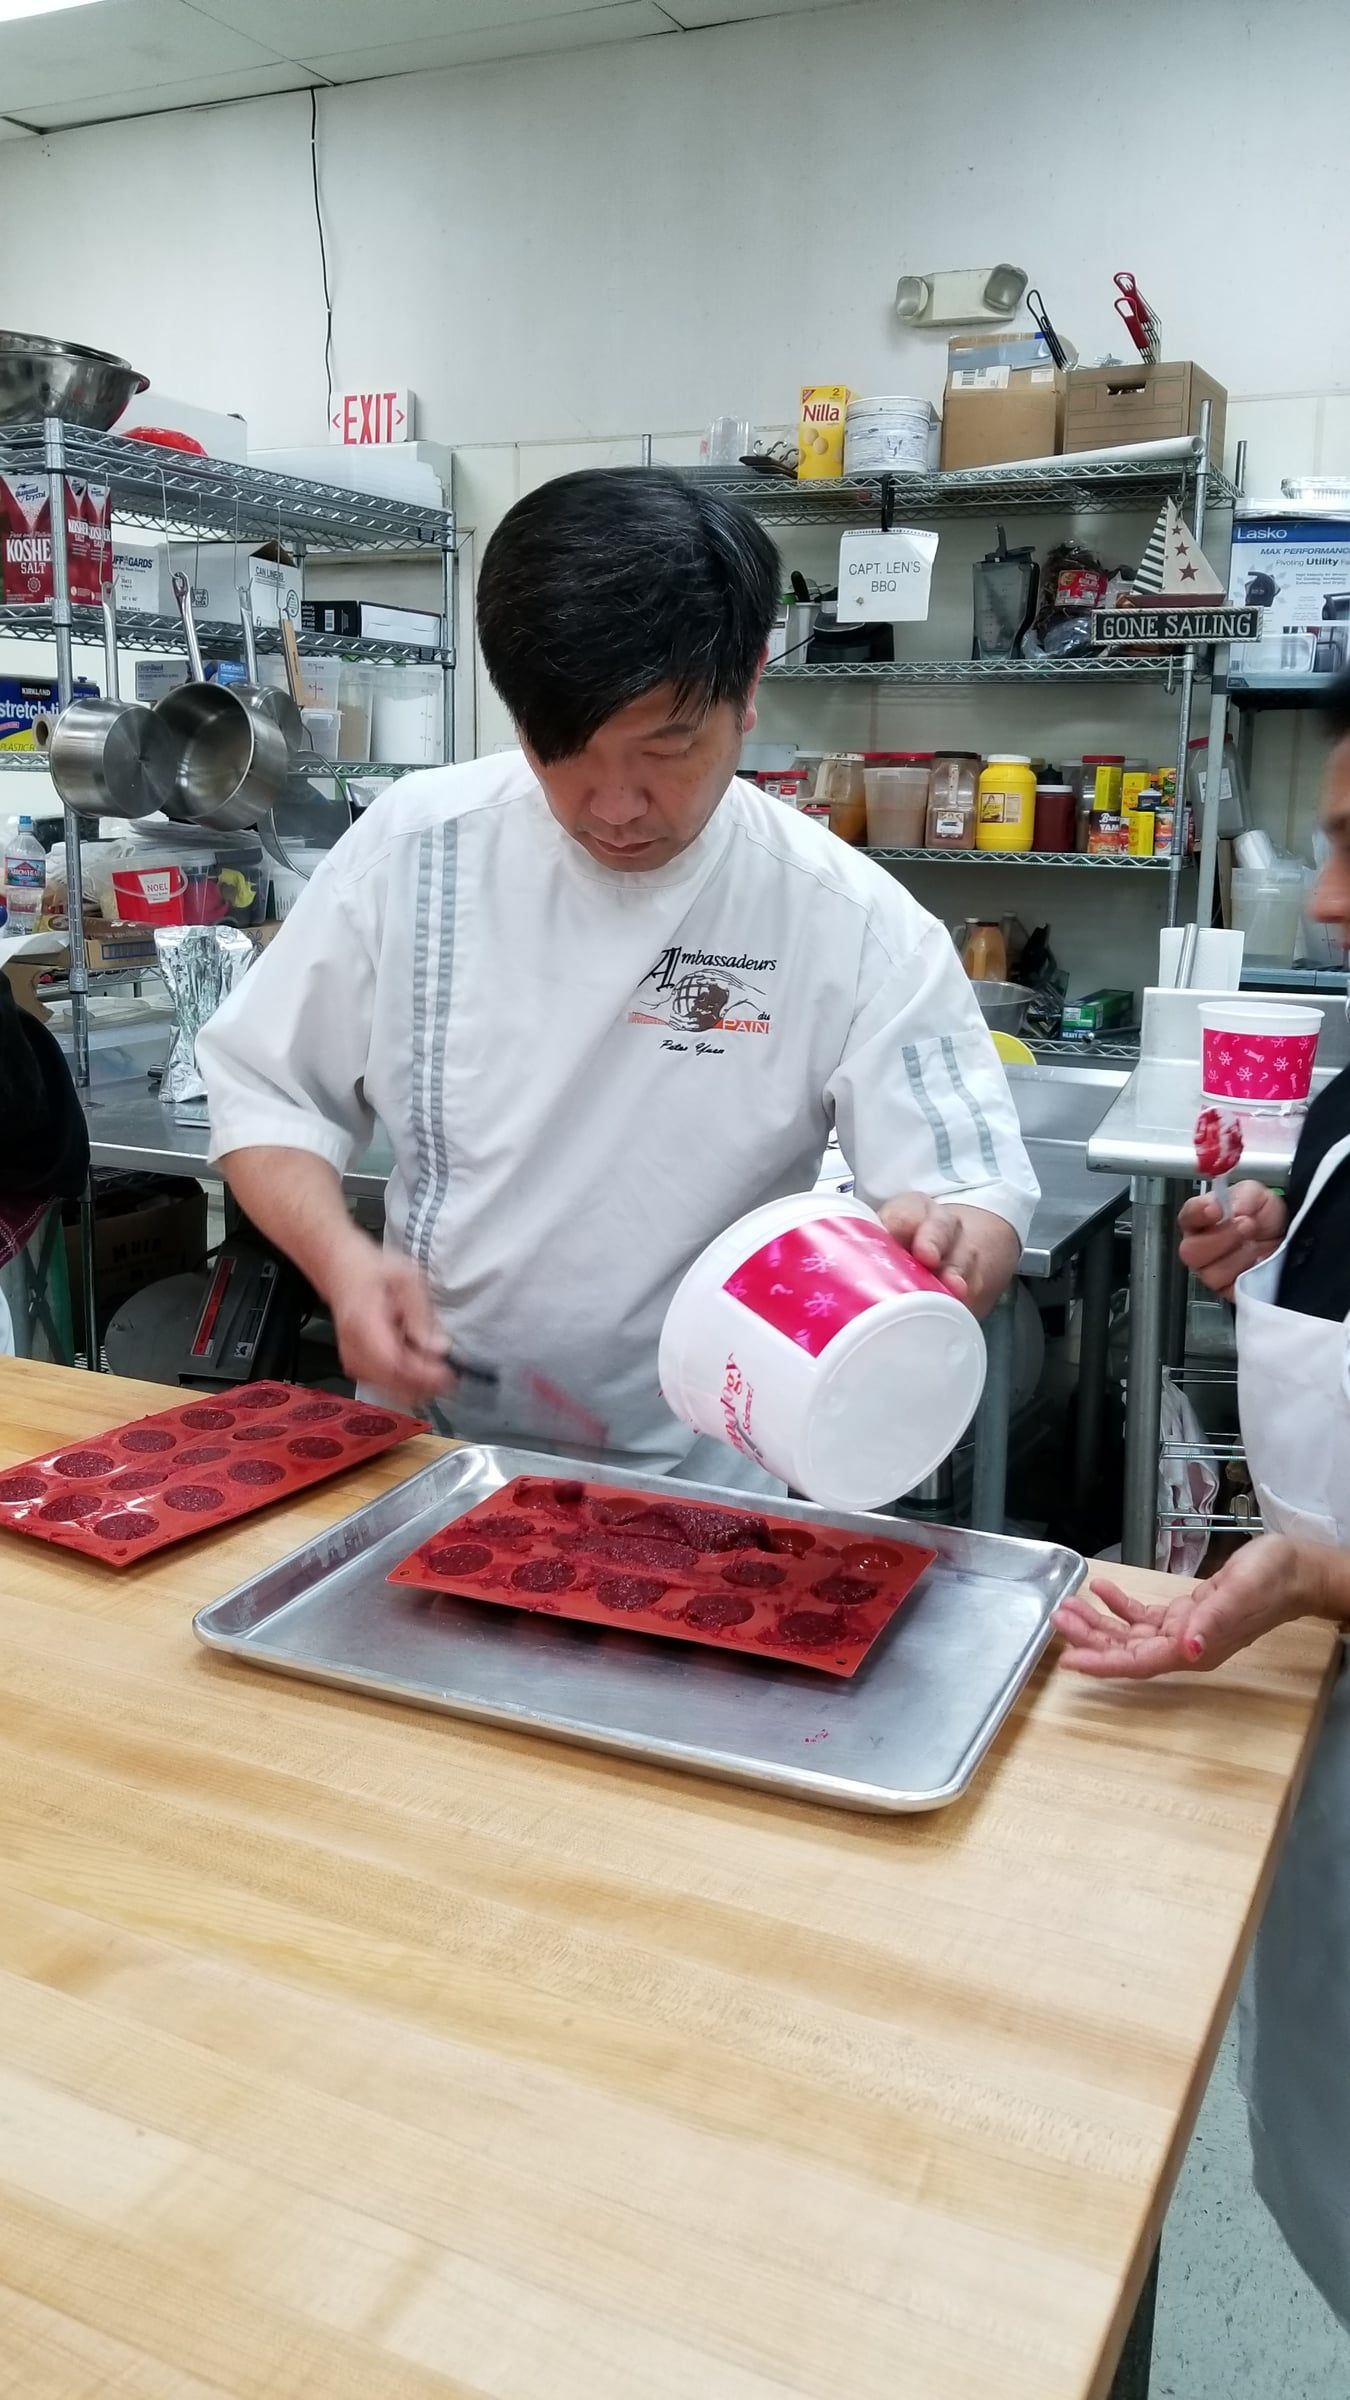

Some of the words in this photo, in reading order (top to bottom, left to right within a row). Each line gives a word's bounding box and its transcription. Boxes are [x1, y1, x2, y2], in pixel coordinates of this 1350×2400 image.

[832, 387, 840, 397] 2
[343, 392, 397, 444] EXIT
[802, 403, 840, 422] Nilla
[1237, 526, 1288, 539] Lasko
[6, 538, 51, 562] KOSHE
[1283, 547, 1350, 555] PERFORMANC
[20, 562, 46, 575] SALT
[128, 557, 153, 569] GARDS
[848, 563, 882, 576] CAPT.
[886, 561, 921, 574] LEN'S
[1306, 557, 1339, 567] Utility
[870, 579, 897, 593] BBQ
[1102, 615, 1159, 639] GONE
[1164, 613, 1251, 638] SAILING
[21, 687, 51, 696] KIRKLAND
[0, 699, 60, 720] stretch-ti
[1099, 823, 1119, 832] YAM
[147, 883, 168, 893] NOEL
[636, 946, 777, 993] Ambassadeurs
[757, 1011, 771, 1021] du
[722, 1019, 768, 1034] PAIN
